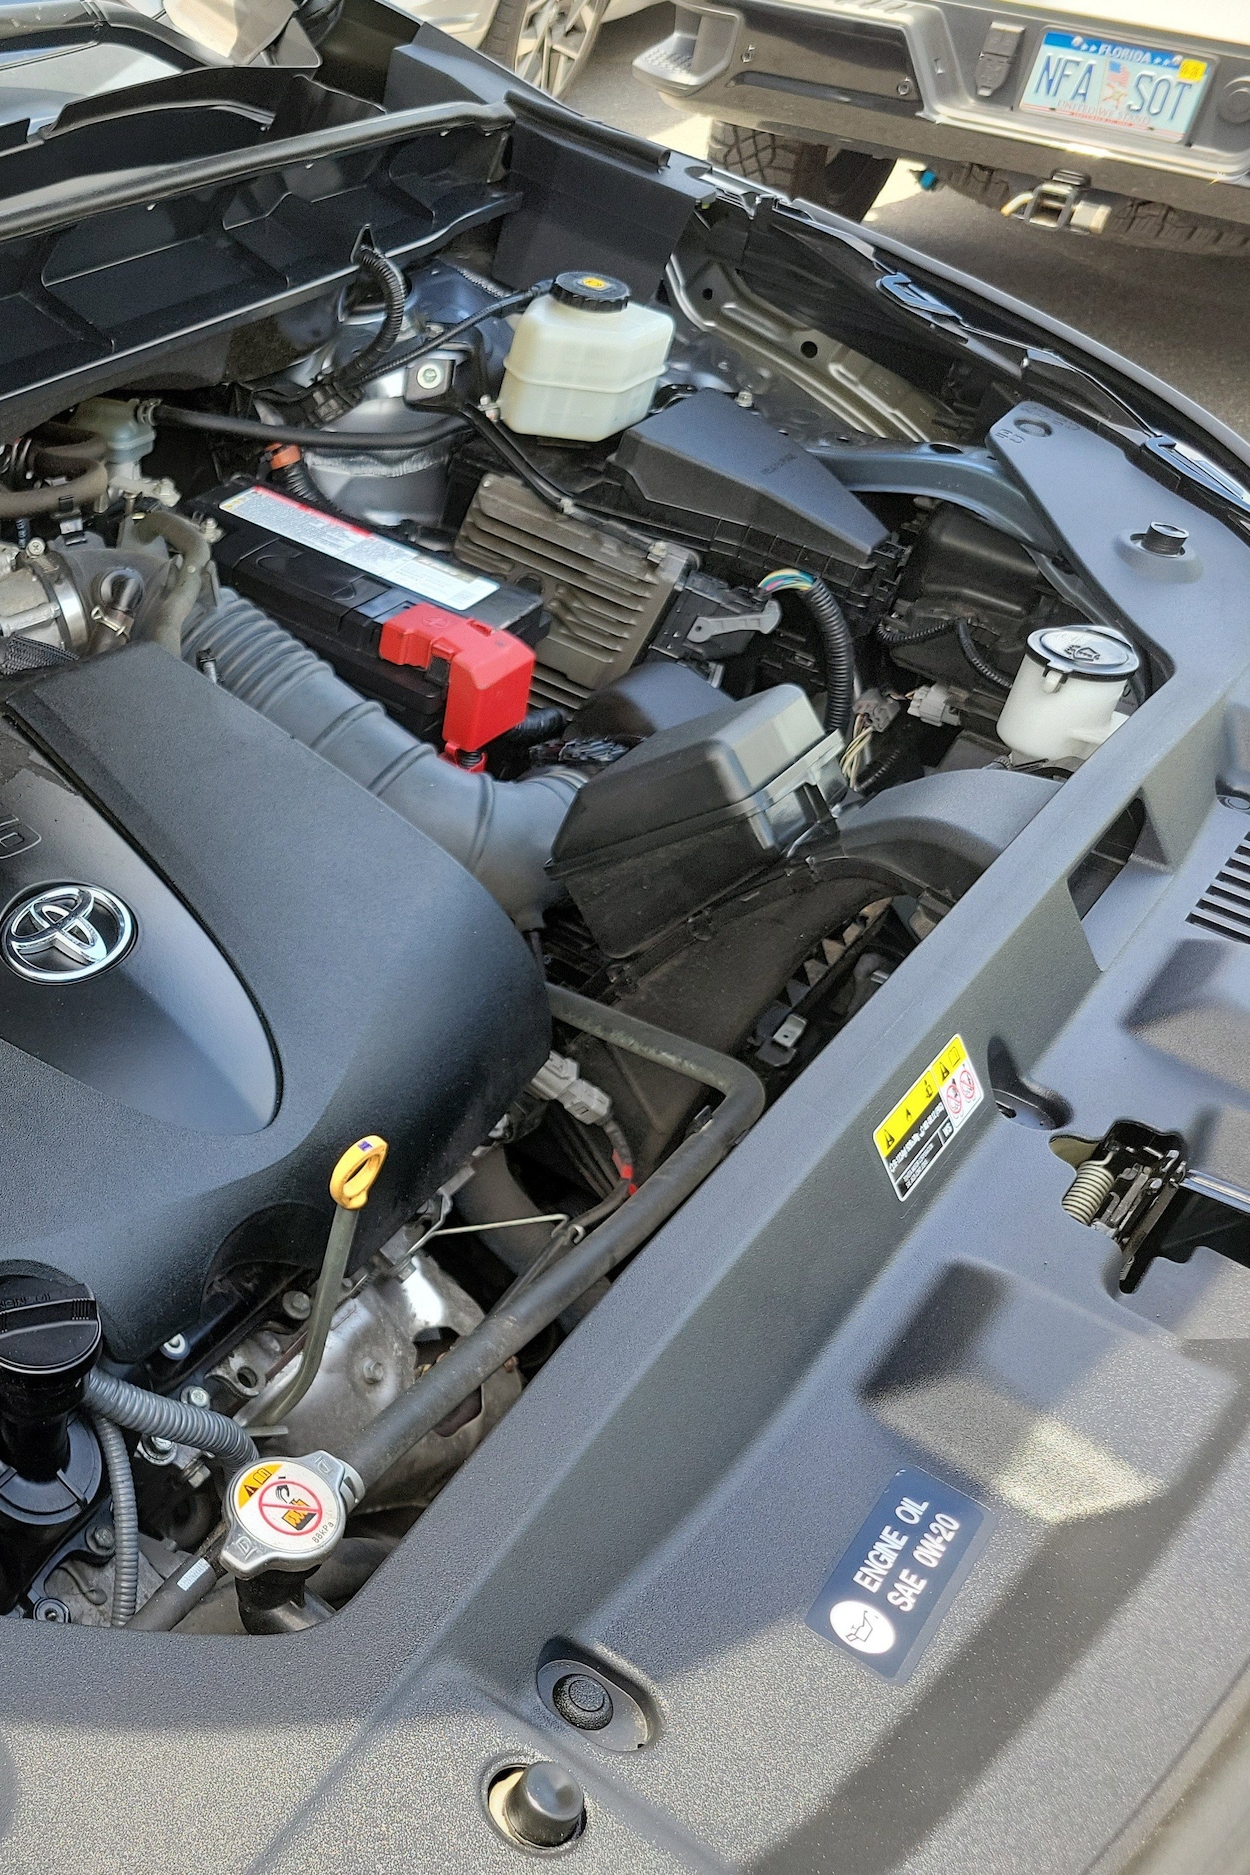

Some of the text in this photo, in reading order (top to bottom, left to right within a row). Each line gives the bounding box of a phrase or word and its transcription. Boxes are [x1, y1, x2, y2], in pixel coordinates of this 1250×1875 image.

[1034, 53, 1096, 102] NFA
[1100, 43, 1151, 64] FLORIDA
[312, 1521, 334, 1543] 88kPa
[852, 1497, 929, 1593] ENGINE OIL
[887, 1513, 960, 1612] SAE 0W-20
